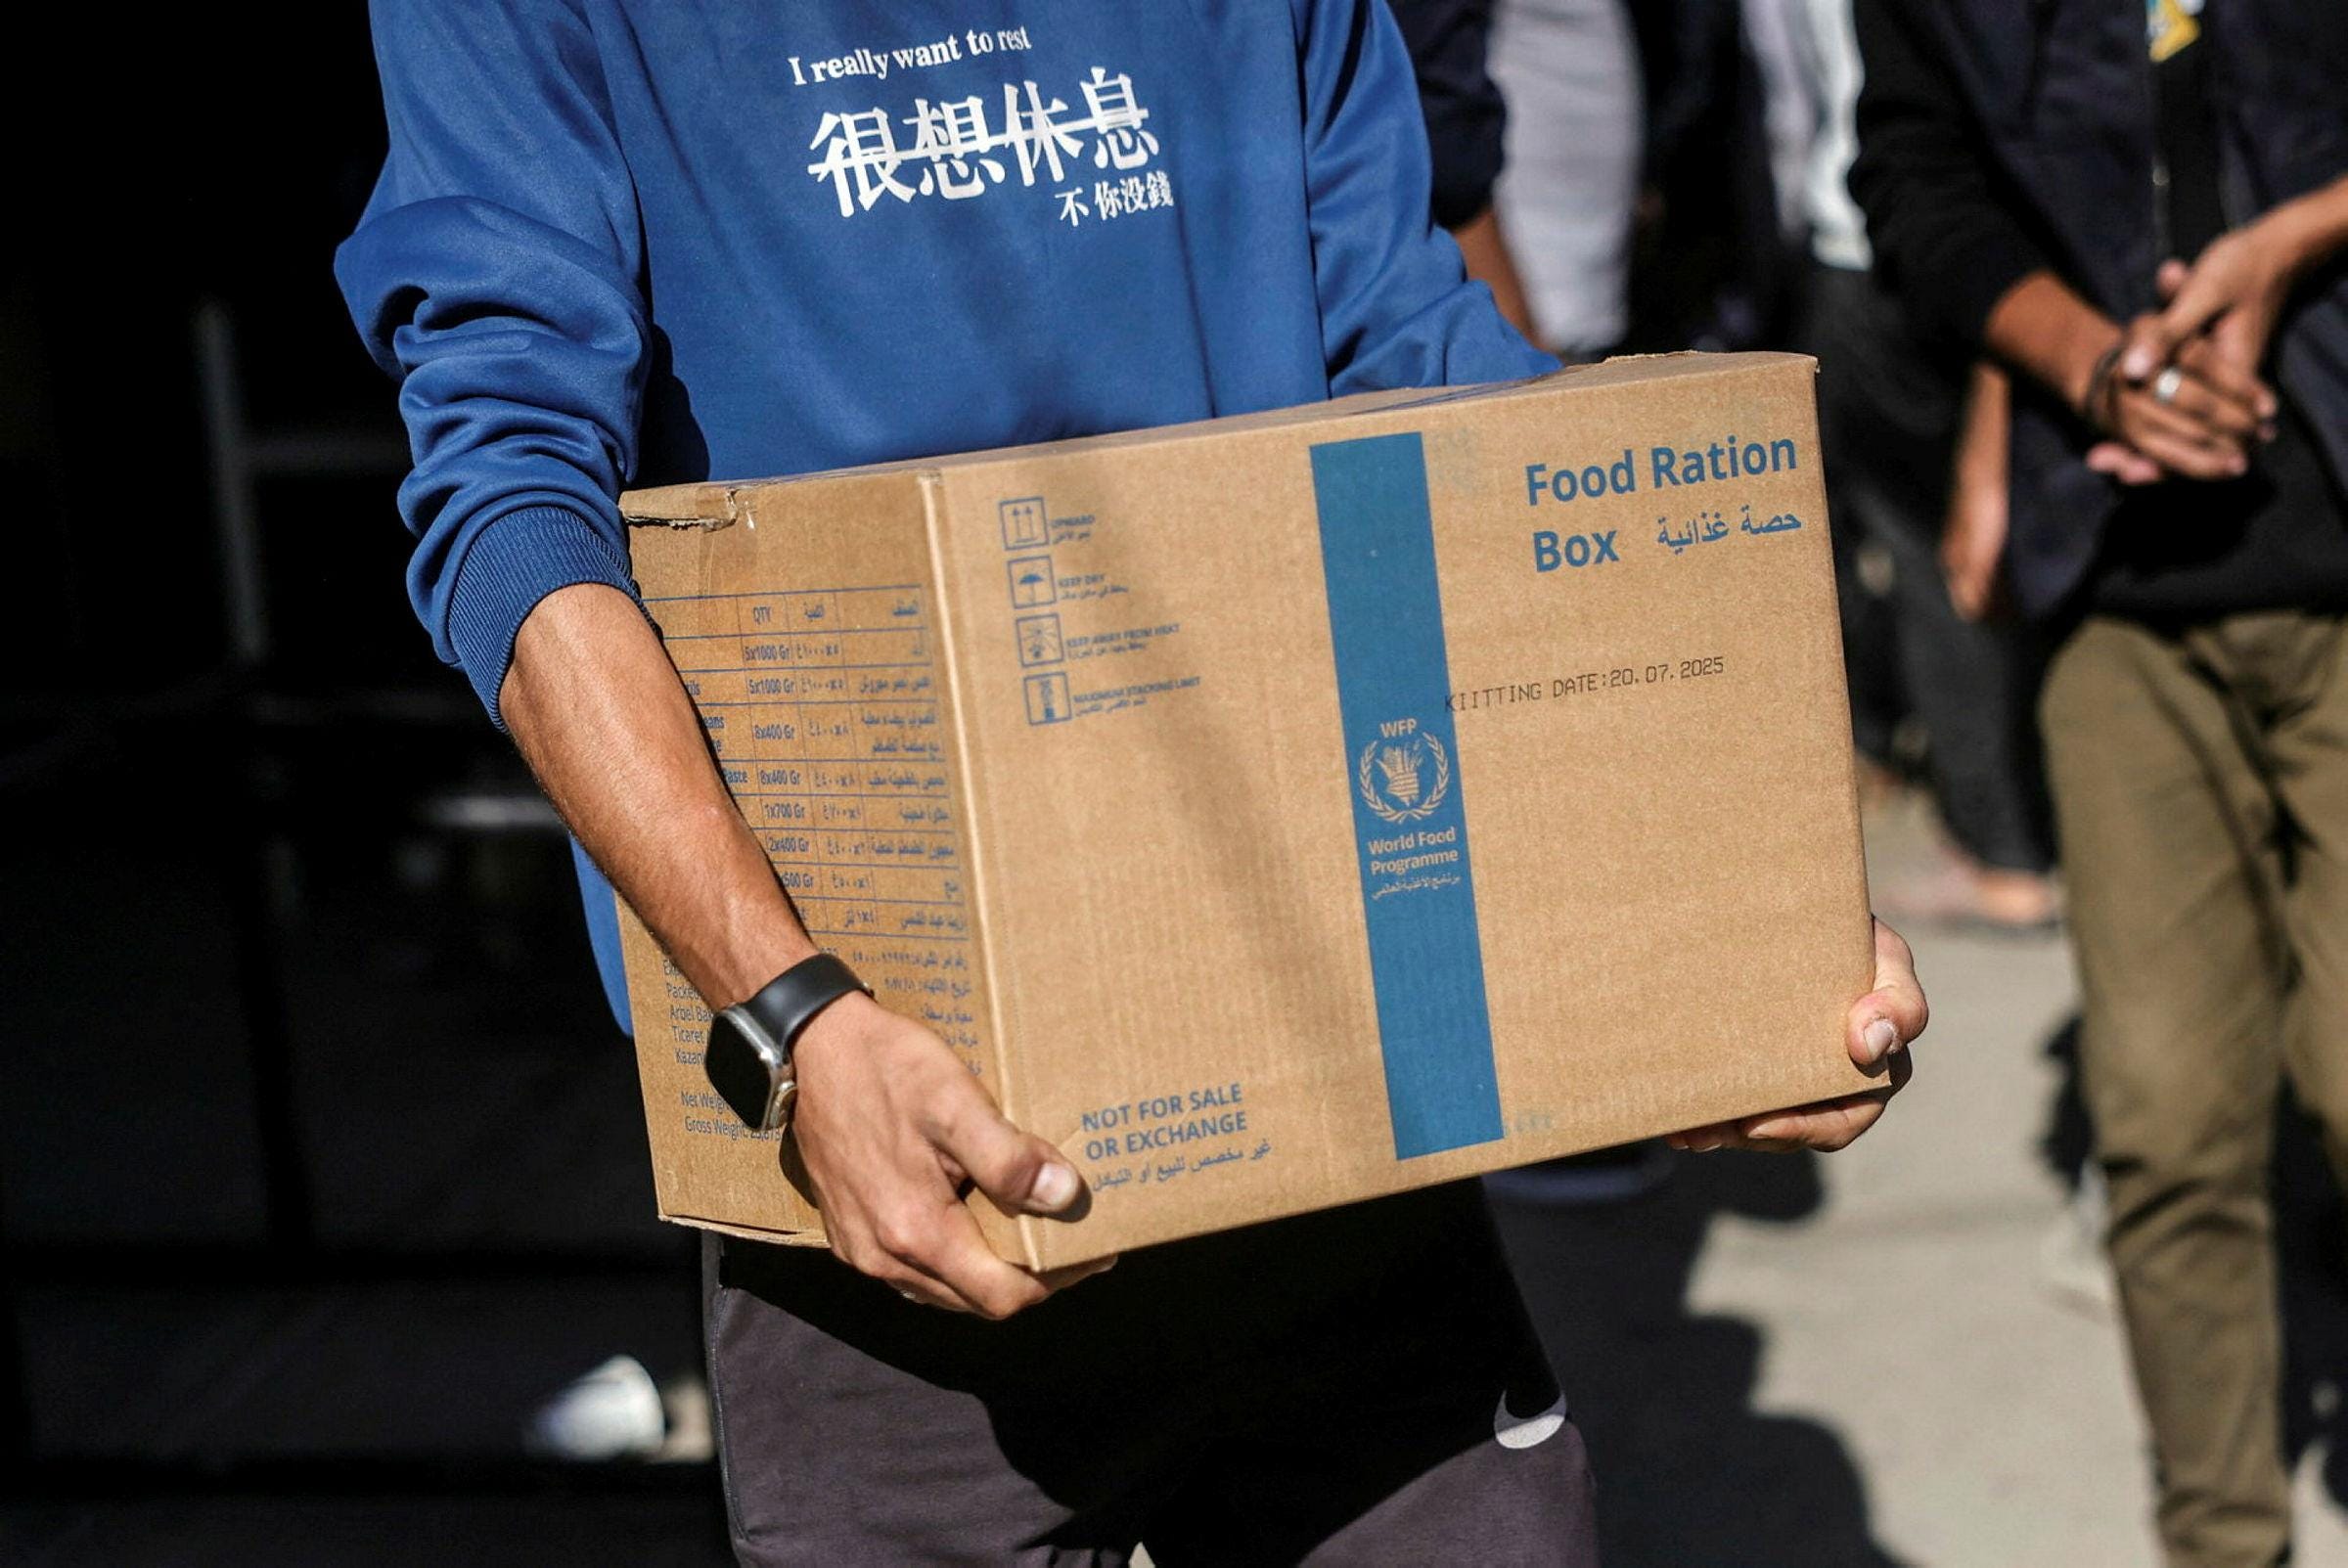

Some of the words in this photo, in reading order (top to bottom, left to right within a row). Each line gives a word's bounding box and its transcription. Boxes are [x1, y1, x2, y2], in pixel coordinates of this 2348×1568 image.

[789, 57, 807, 85] I
[810, 48, 889, 79] really
[892, 35, 963, 69] want
[966, 29, 993, 57] to
[998, 25, 1032, 51] rest
[807, 67, 1160, 218] 很想休息
[1055, 188, 1089, 227] 不
[1525, 449, 1636, 506] Food
[1650, 435, 1797, 489] Ration
[1657, 511, 1730, 555] غذائية
[1740, 505, 1802, 536] حصة
[1533, 530, 1620, 572] Box
[752, 605, 772, 625] QTY
[779, 645, 791, 660] Gr
[783, 678, 795, 694] Gr
[1444, 683, 1543, 713] KIITTING
[784, 724, 795, 739] Gr
[1379, 718, 1417, 739] WFP
[789, 770, 800, 785] Gr
[793, 803, 805, 819] Gr
[798, 836, 810, 852] Gr
[1369, 833, 1415, 857] World
[1419, 827, 1457, 847] Food
[1371, 849, 1460, 875] Programme
[1082, 1104, 1131, 1132] NOT
[1139, 1095, 1183, 1121] FOR
[1190, 1083, 1243, 1111] SALE
[685, 1115, 712, 1134] Gross
[1086, 1138, 1119, 1160] OR
[1126, 1111, 1247, 1153] EXCHANGE
[1190, 1147, 1244, 1173] مخصص
[1250, 1139, 1272, 1160] غير
[1156, 1155, 1186, 1183] للبيع
